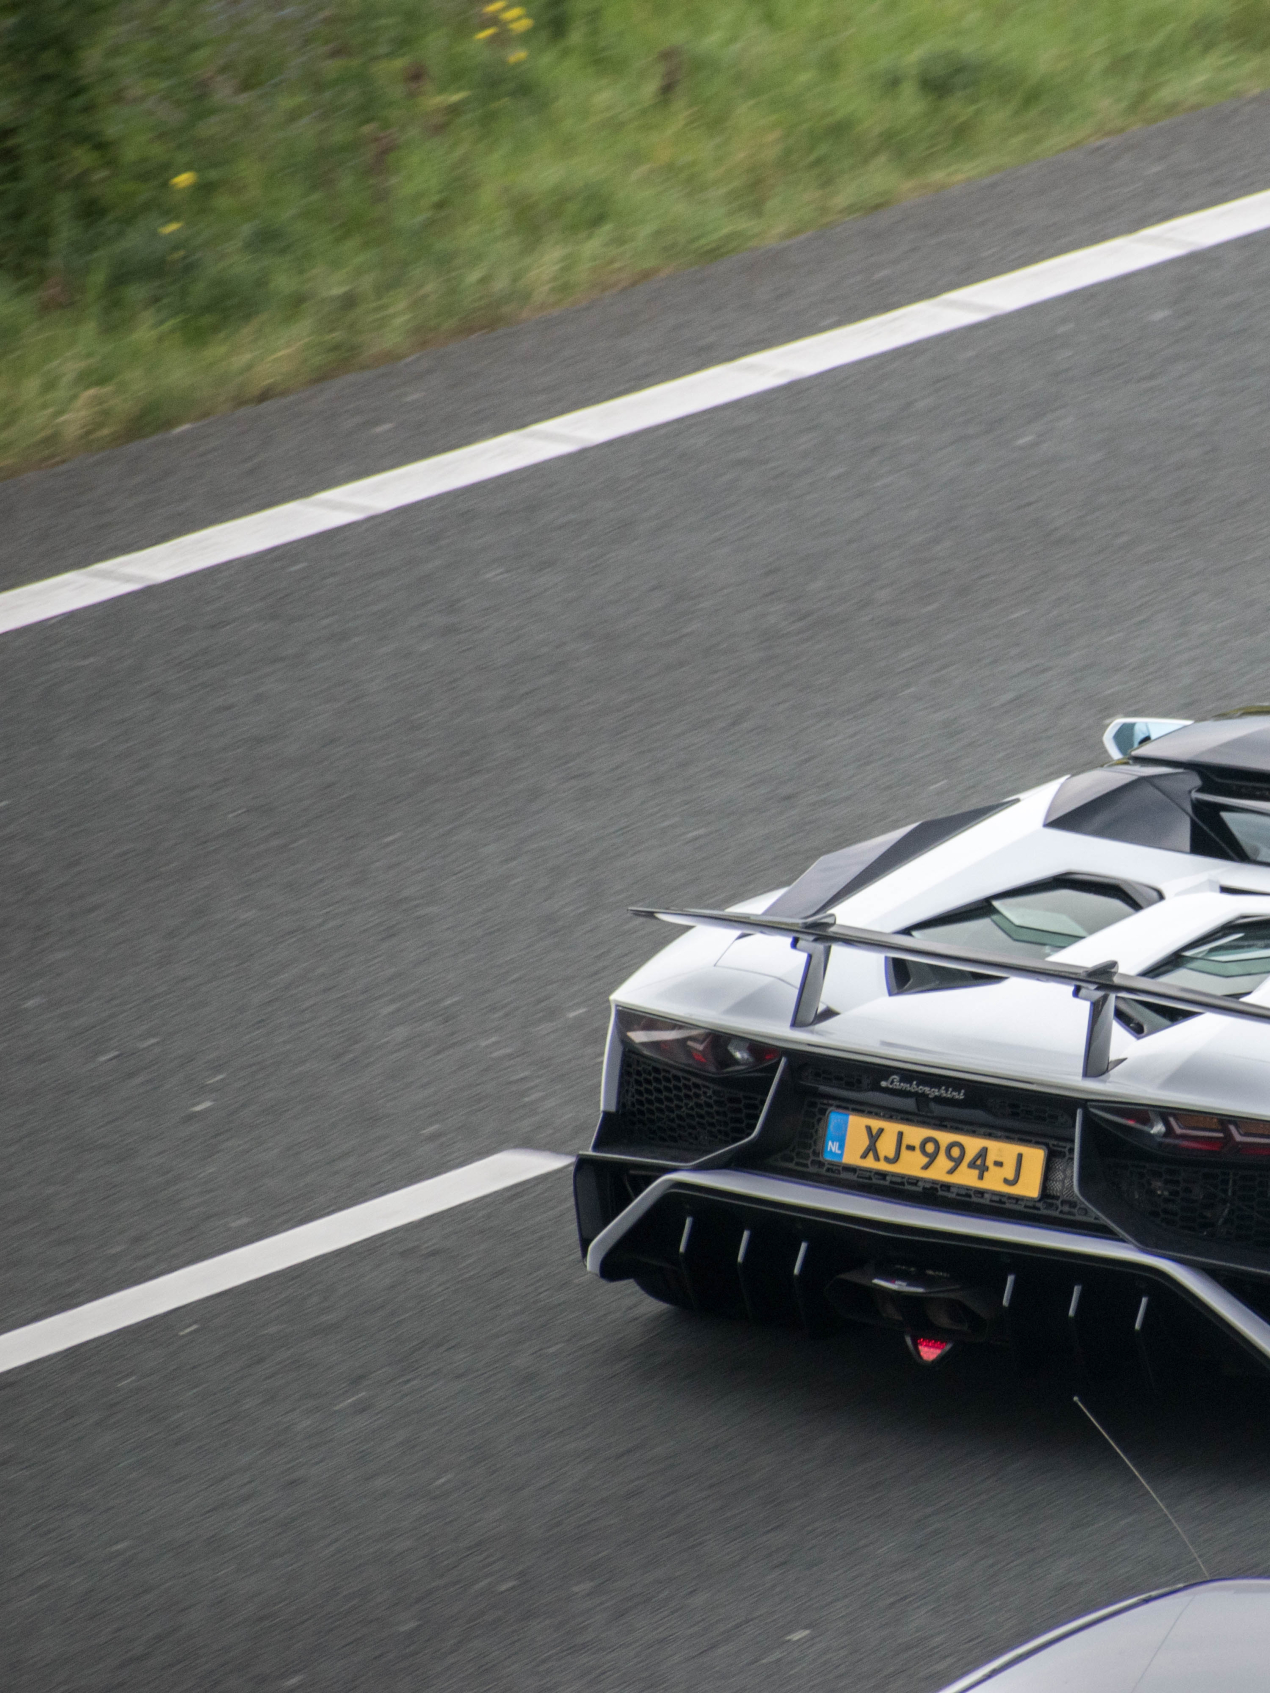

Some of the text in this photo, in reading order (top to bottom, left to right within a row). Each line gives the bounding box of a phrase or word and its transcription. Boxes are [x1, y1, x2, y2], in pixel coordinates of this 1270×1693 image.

[880, 1075, 965, 1099] Lamborghini
[827, 1141, 842, 1154] NL
[860, 1124, 1023, 1187] XJ-994-J
